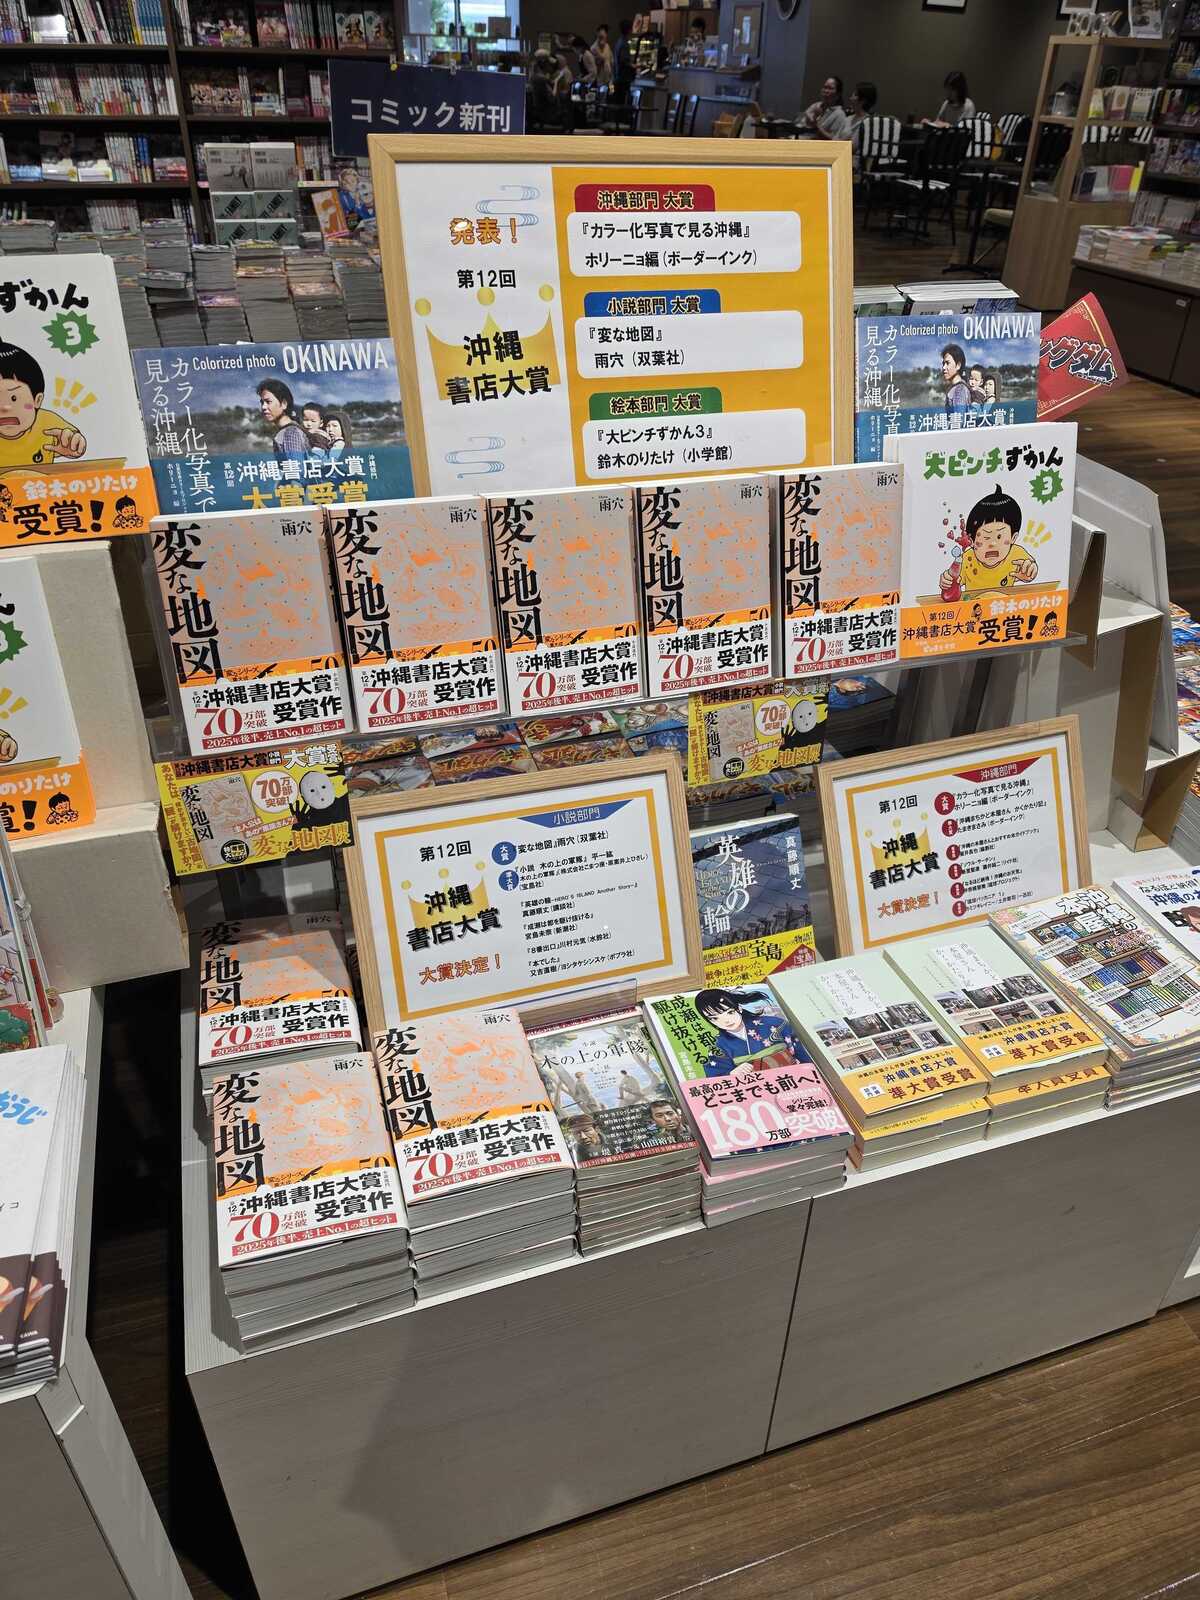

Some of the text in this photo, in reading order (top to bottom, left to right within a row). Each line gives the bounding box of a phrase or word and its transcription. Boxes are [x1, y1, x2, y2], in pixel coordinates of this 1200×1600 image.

[351, 98, 510, 132] コミック新刊
[598, 191, 694, 210] 沖縄部門 大賞
[450, 217, 519, 245] 発表！
[582, 221, 751, 239] 『カラー化写真で見る沖縄』
[457, 269, 516, 288] 第12回
[608, 297, 700, 315] 小説部門 大賞
[61, 320, 82, 346] 3
[589, 325, 663, 343] 『変な地図』
[900, 316, 1035, 340] Colorized photo OKINAWA
[192, 342, 389, 374] Colorized photo OKINAWA
[463, 330, 524, 367] 沖縄
[863, 326, 883, 407] 見る沖縄
[445, 367, 552, 406] 書店大賞
[144, 359, 183, 456] 見る沖縄
[611, 394, 701, 415] 絵本部門 大賞
[919, 408, 1006, 431] 沖縄書店大賞
[170, 357, 217, 513] カラー化写真で
[237, 455, 366, 482] 沖縄書店大賞
[923, 444, 1064, 480] 大ピンチずかん
[22, 475, 138, 499] 鈴木のりたけ
[242, 481, 369, 509] 大賞受賞
[786, 474, 822, 616] 変な地図
[493, 498, 542, 650] 変な地図
[641, 487, 684, 633] 変な地図
[333, 509, 393, 664] 変な地図
[153, 522, 219, 684] 変な地図
[929, 611, 954, 622] 第12回
[800, 609, 893, 637] 沖縄書店大賞
[903, 621, 976, 641] 沖縄書店大賞
[666, 624, 764, 654] 沖縄書店大賞
[792, 637, 826, 662] 70
[848, 628, 897, 652] 受賞作
[525, 642, 631, 672] 沖縄書店大賞
[658, 654, 694, 680] 70
[717, 644, 768, 669] 受賞作
[370, 656, 488, 687] 沖縄書店大賞
[517, 671, 556, 698] 70
[581, 661, 637, 688] 受賞作
[202, 674, 332, 708] 沖縄書店大賞
[362, 687, 406, 714] 70
[433, 677, 496, 704] 受賞作
[195, 708, 242, 736] 70
[272, 696, 343, 724] 受賞作
[760, 705, 778, 723] 70
[181, 753, 268, 776] 沖縄書店大賞
[980, 764, 1018, 780] 沖縄部門
[256, 778, 281, 799] 70
[181, 785, 214, 842] 変な地図
[553, 806, 600, 825] 小説部門
[879, 795, 918, 814] 第12回
[419, 840, 472, 862] 第12回
[882, 832, 919, 859] 沖縄
[703, 835, 759, 935] 英雄の輪
[869, 852, 940, 890] 書店大賞
[423, 883, 473, 916] 沖縄
[406, 907, 502, 952] 書店大賞
[748, 940, 783, 961] 宝島
[200, 922, 243, 1014] 変な地図
[220, 1000, 341, 1028] 沖縄書店大賞
[282, 1014, 350, 1034] 受賞作
[210, 1025, 252, 1047] 70
[1003, 1022, 1073, 1045] 沖縄書店大賞
[1009, 1031, 1093, 1060] 準大賞受賞
[541, 1040, 649, 1069] 木の上の軍隊
[376, 1026, 437, 1140] 変な地図
[883, 1056, 958, 1084] 沖縄書店大賞
[888, 1067, 976, 1100] 準大賞受賞
[689, 1072, 765, 1098] 最高の主人公と
[792, 1096, 815, 1104] シリーズ
[213, 1071, 265, 1197] 変な地図
[413, 1115, 543, 1156] 沖縄書店大賞
[699, 1101, 786, 1150] 180
[767, 1127, 792, 1141] 万部
[484, 1132, 555, 1162] 受賞作
[406, 1152, 453, 1182] 70
[238, 1171, 384, 1215] 沖縄書店大賞
[314, 1191, 394, 1222] 受賞作
[228, 1211, 279, 1243] 70
